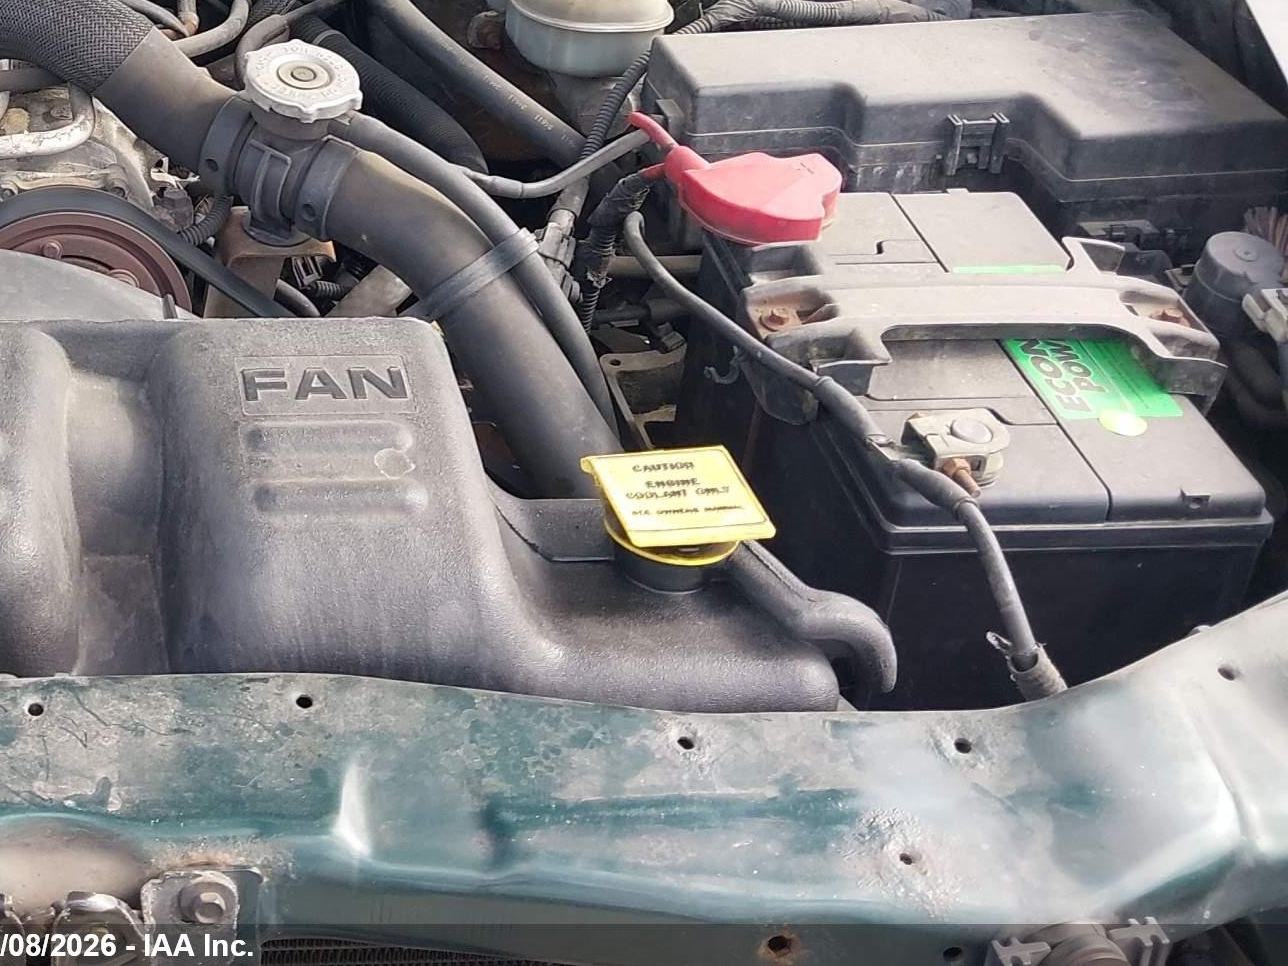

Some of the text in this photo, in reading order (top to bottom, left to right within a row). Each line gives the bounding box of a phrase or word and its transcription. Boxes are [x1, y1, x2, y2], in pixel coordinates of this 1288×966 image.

[1042, 339, 1106, 393] POW
[241, 366, 409, 401] FAN
[632, 462, 695, 472] CAUTION
[645, 478, 701, 488] ENGINE
[626, 486, 730, 499] COOLANT ONLY
